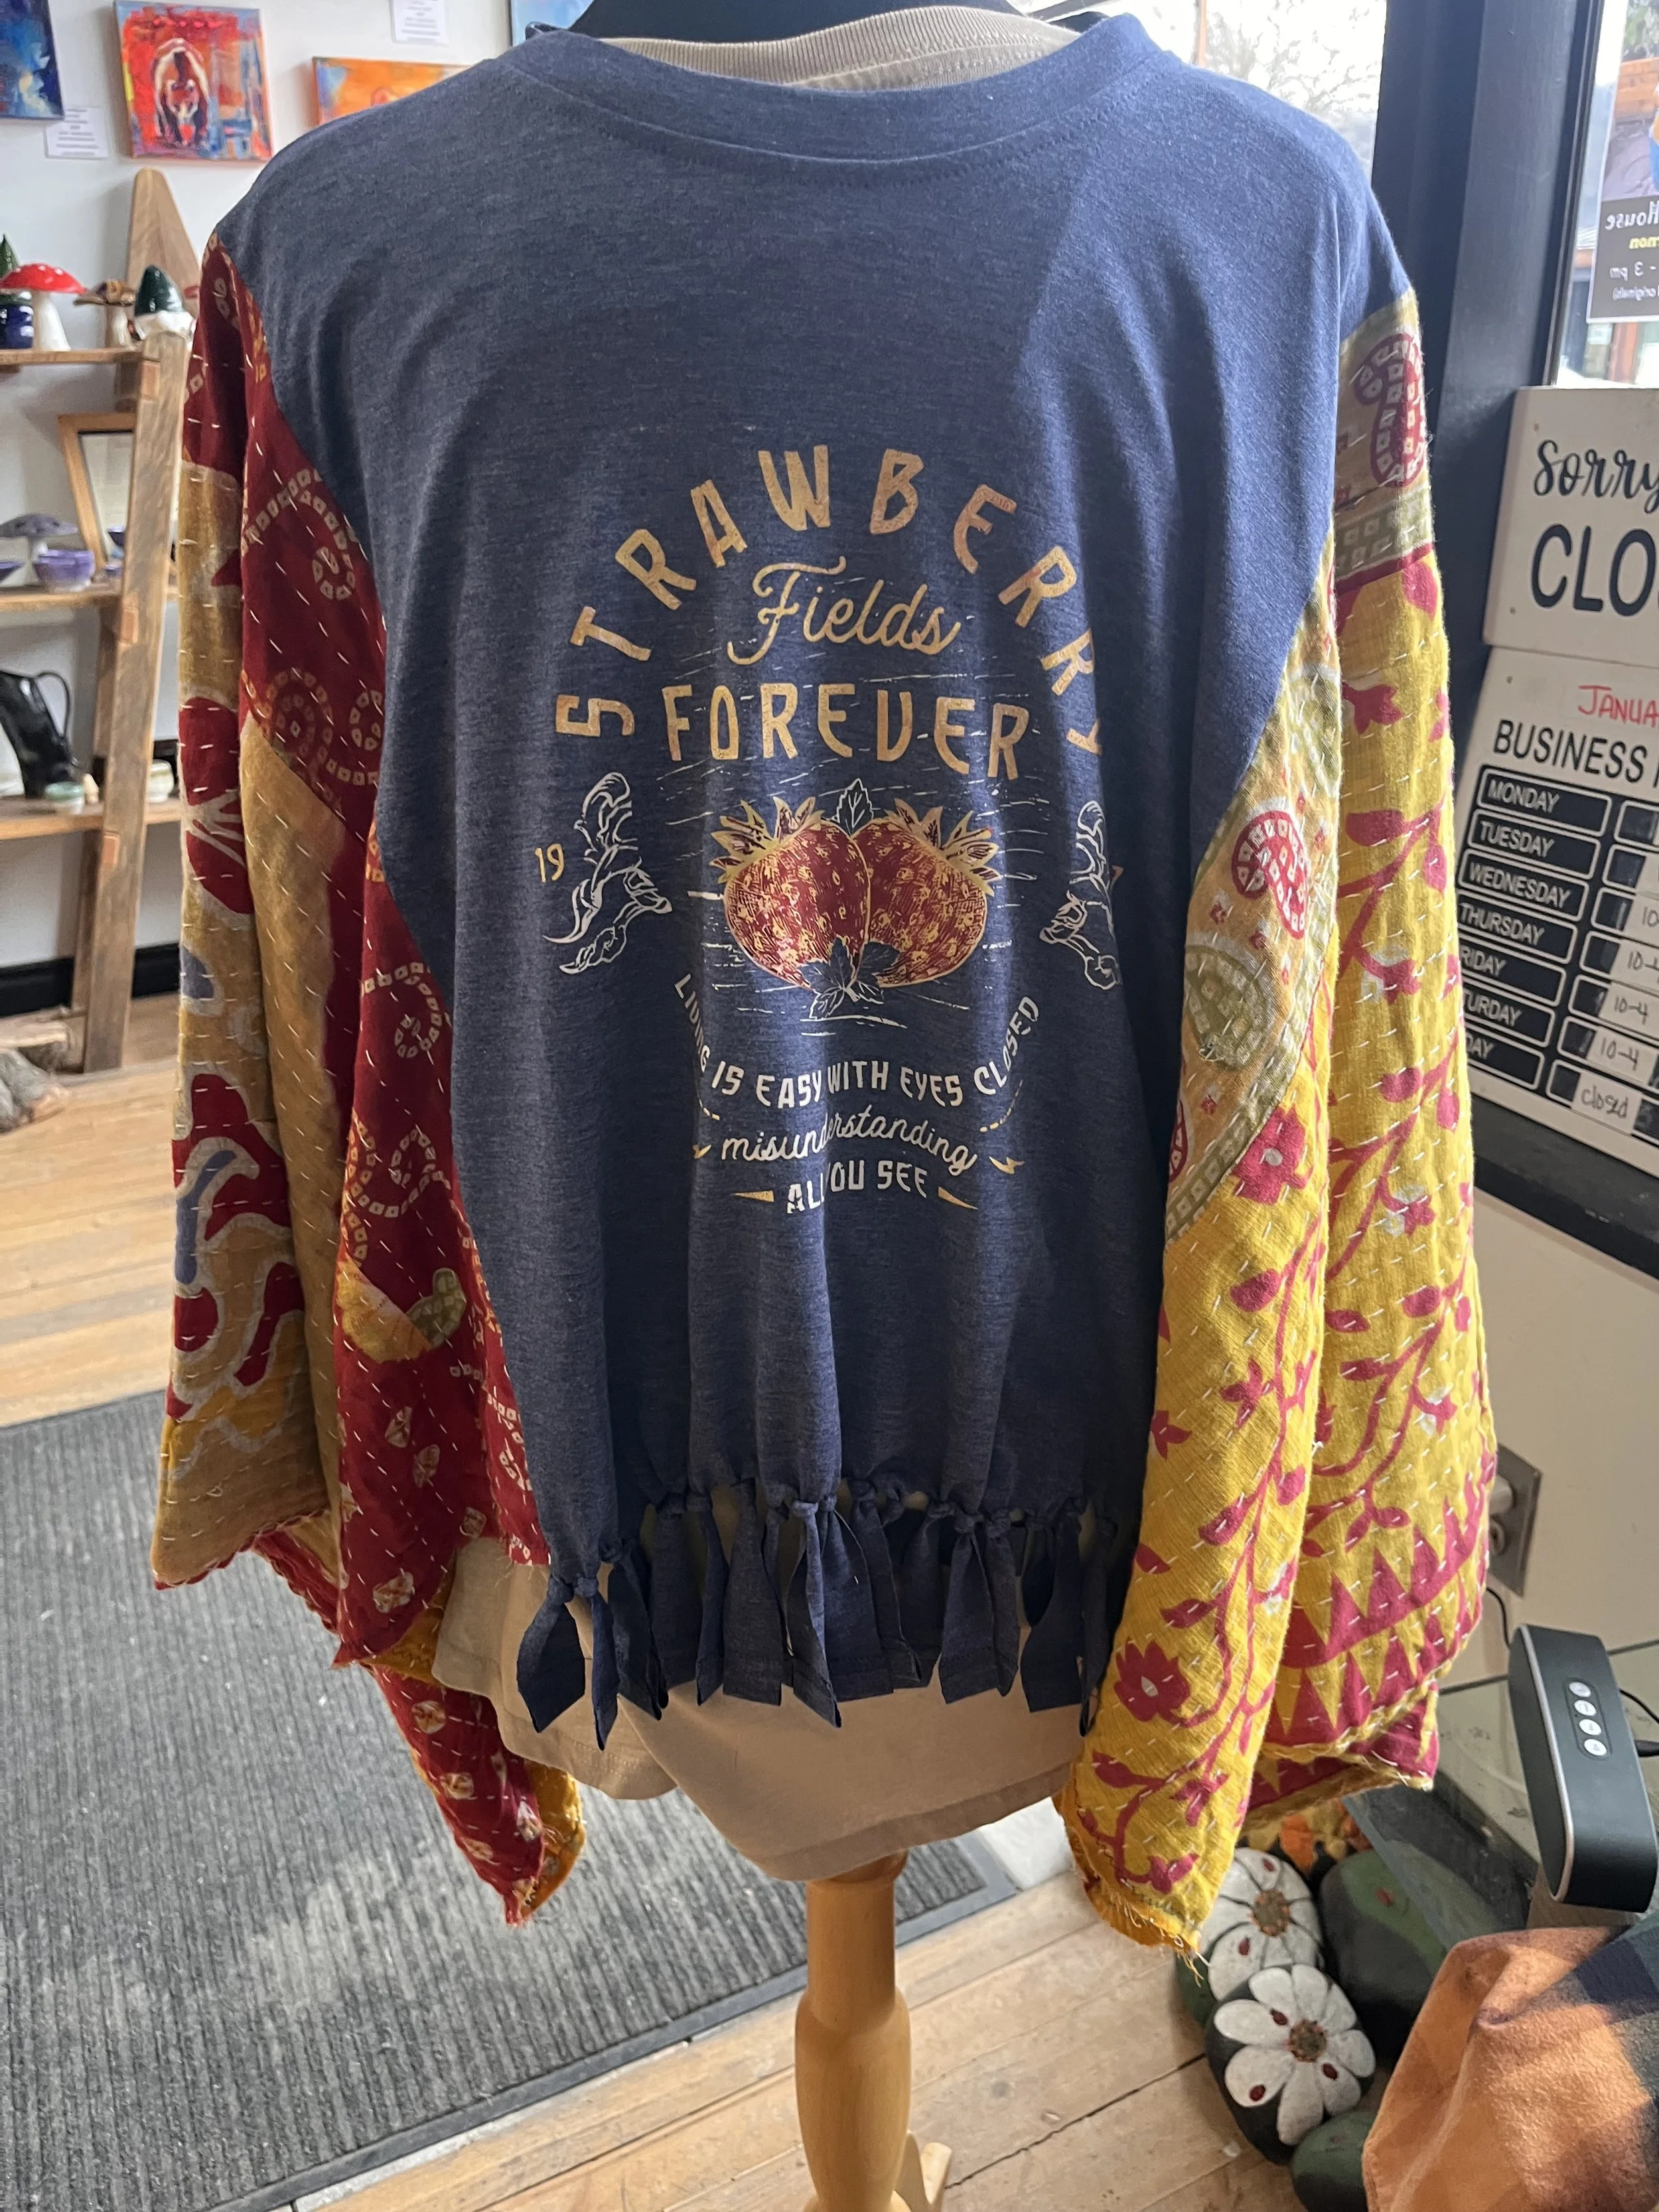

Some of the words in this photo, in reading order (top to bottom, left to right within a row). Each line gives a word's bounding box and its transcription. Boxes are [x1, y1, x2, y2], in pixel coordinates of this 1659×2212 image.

[1531, 524, 1659, 617] CLO
[556, 445, 1102, 755] STRAWBERRY
[727, 555, 961, 666] Fields
[1577, 685, 1659, 727] JANUA
[662, 683, 1029, 780] FOREVER
[1493, 719, 1647, 782] BUSINESS
[1488, 779, 1560, 813] MONDAY
[1480, 821, 1555, 857] TUESDAY
[535, 844, 564, 883] 19
[1469, 861, 1571, 909] WEDNESDAY
[1460, 903, 1545, 946] THURSDAY
[1460, 944, 1506, 977] RIDAY
[1614, 997, 1648, 1025] 10-4
[711, 1061, 745, 1095] IS
[757, 1070, 822, 1108] EASY
[828, 1061, 889, 1093] WITH
[901, 1067, 963, 1106] EYES
[974, 995, 1039, 1095] CLOSED
[1465, 1032, 1494, 1059] DAY
[1601, 1036, 1639, 1071] 10-4
[721, 1104, 977, 1176] misunderstanding
[877, 1161, 927, 1199] SEE
